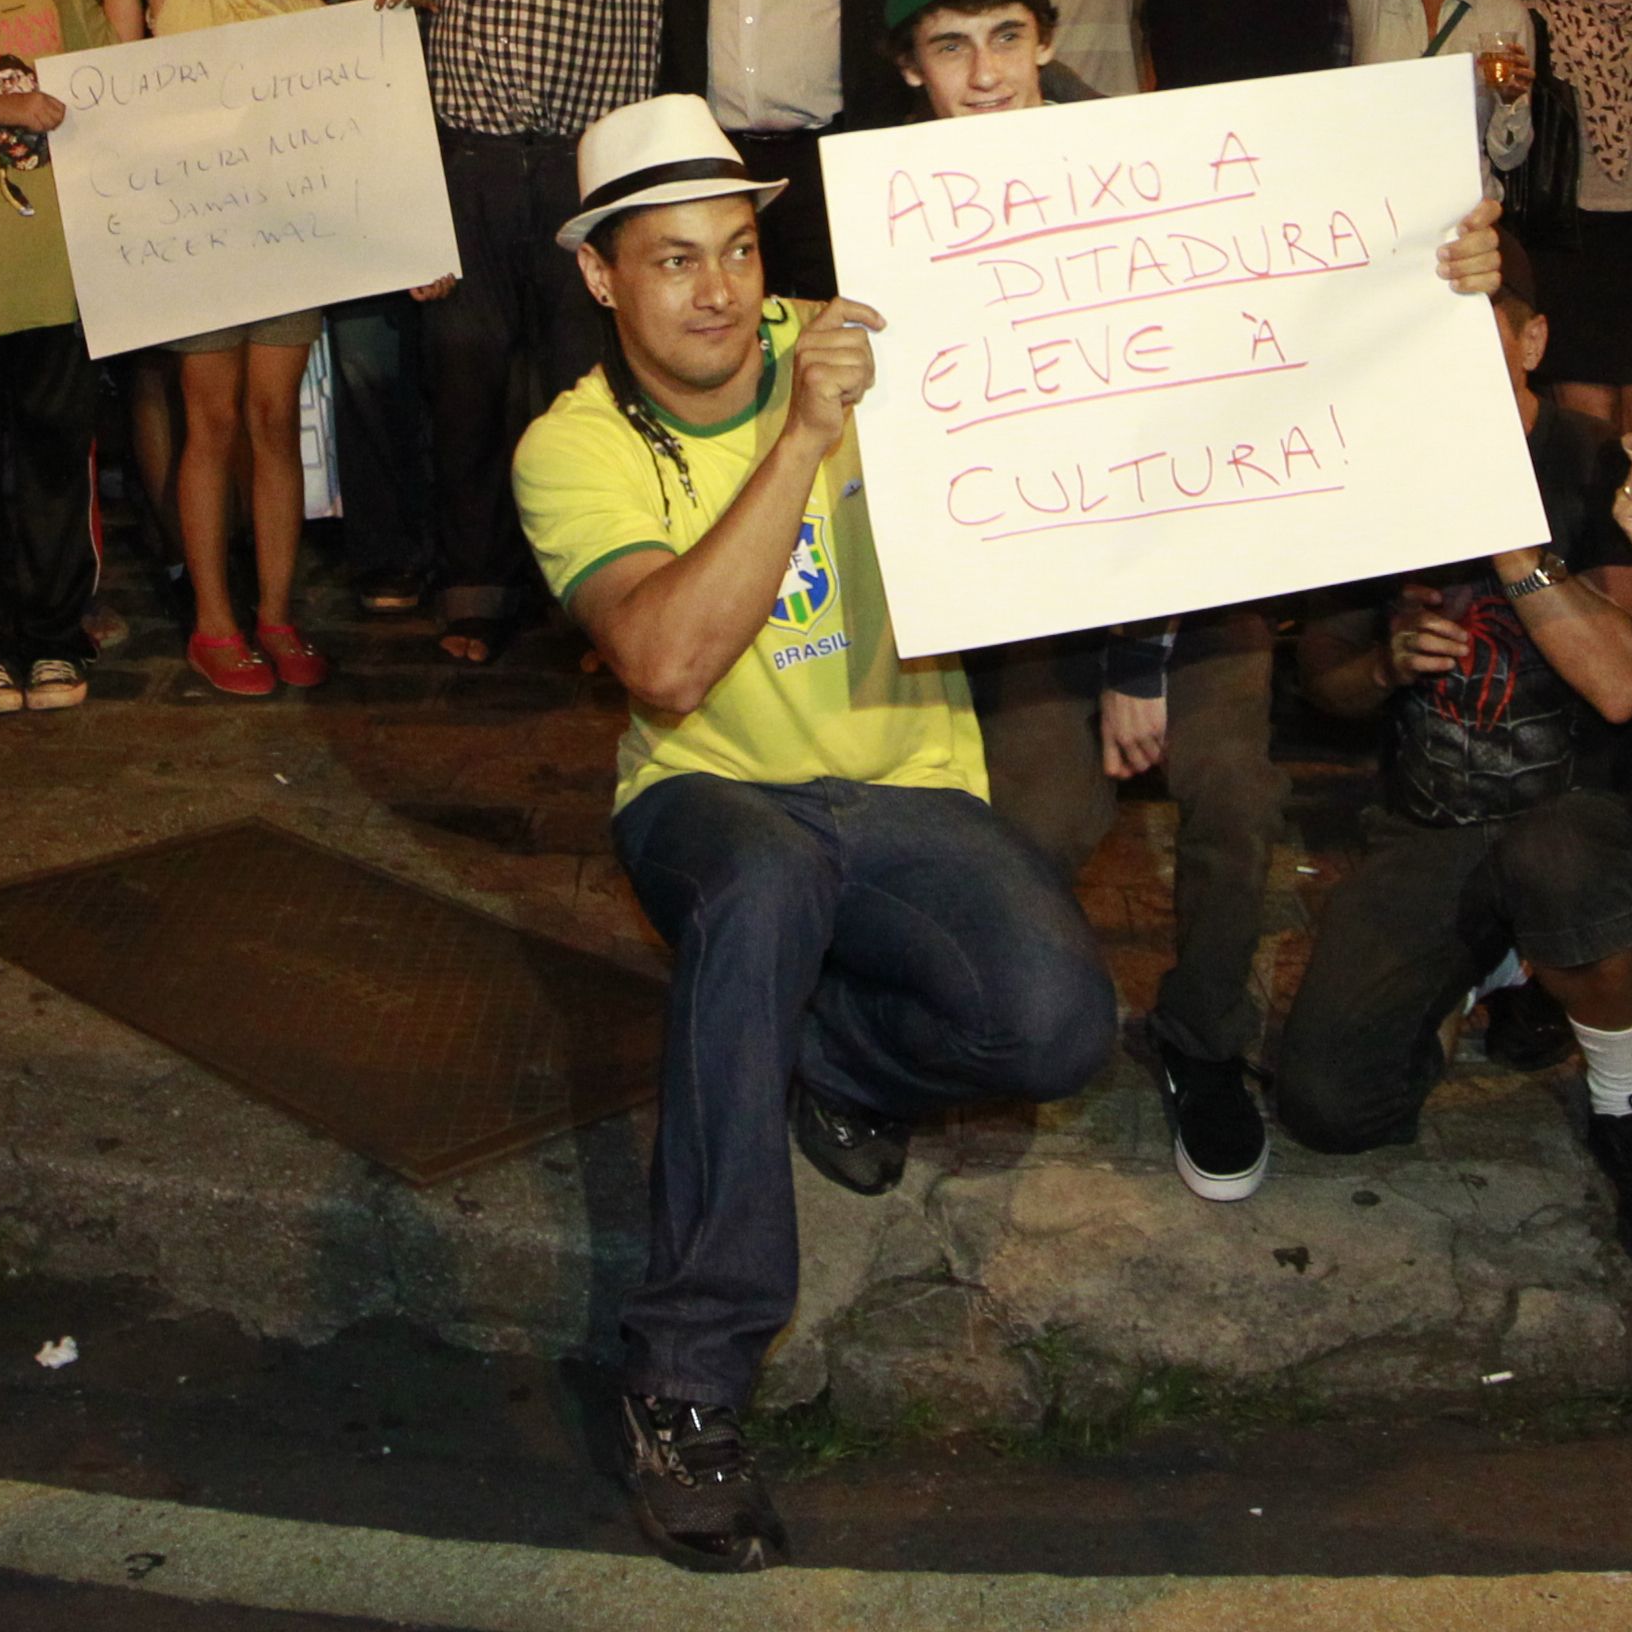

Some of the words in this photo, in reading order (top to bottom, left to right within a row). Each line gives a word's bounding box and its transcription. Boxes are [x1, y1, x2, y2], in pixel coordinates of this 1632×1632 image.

[70, 62, 211, 111] QUADRA
[220, 14, 393, 110] CULTURAL!
[90, 145, 250, 199] CULTURA
[1209, 131, 1259, 191] A
[979, 197, 1399, 307] DITADURA!
[921, 325, 1174, 412] ELEVE
[1241, 313, 1287, 363] À
[948, 404, 1349, 526] CULTURA!
[772, 632, 853, 671] BRASIL
